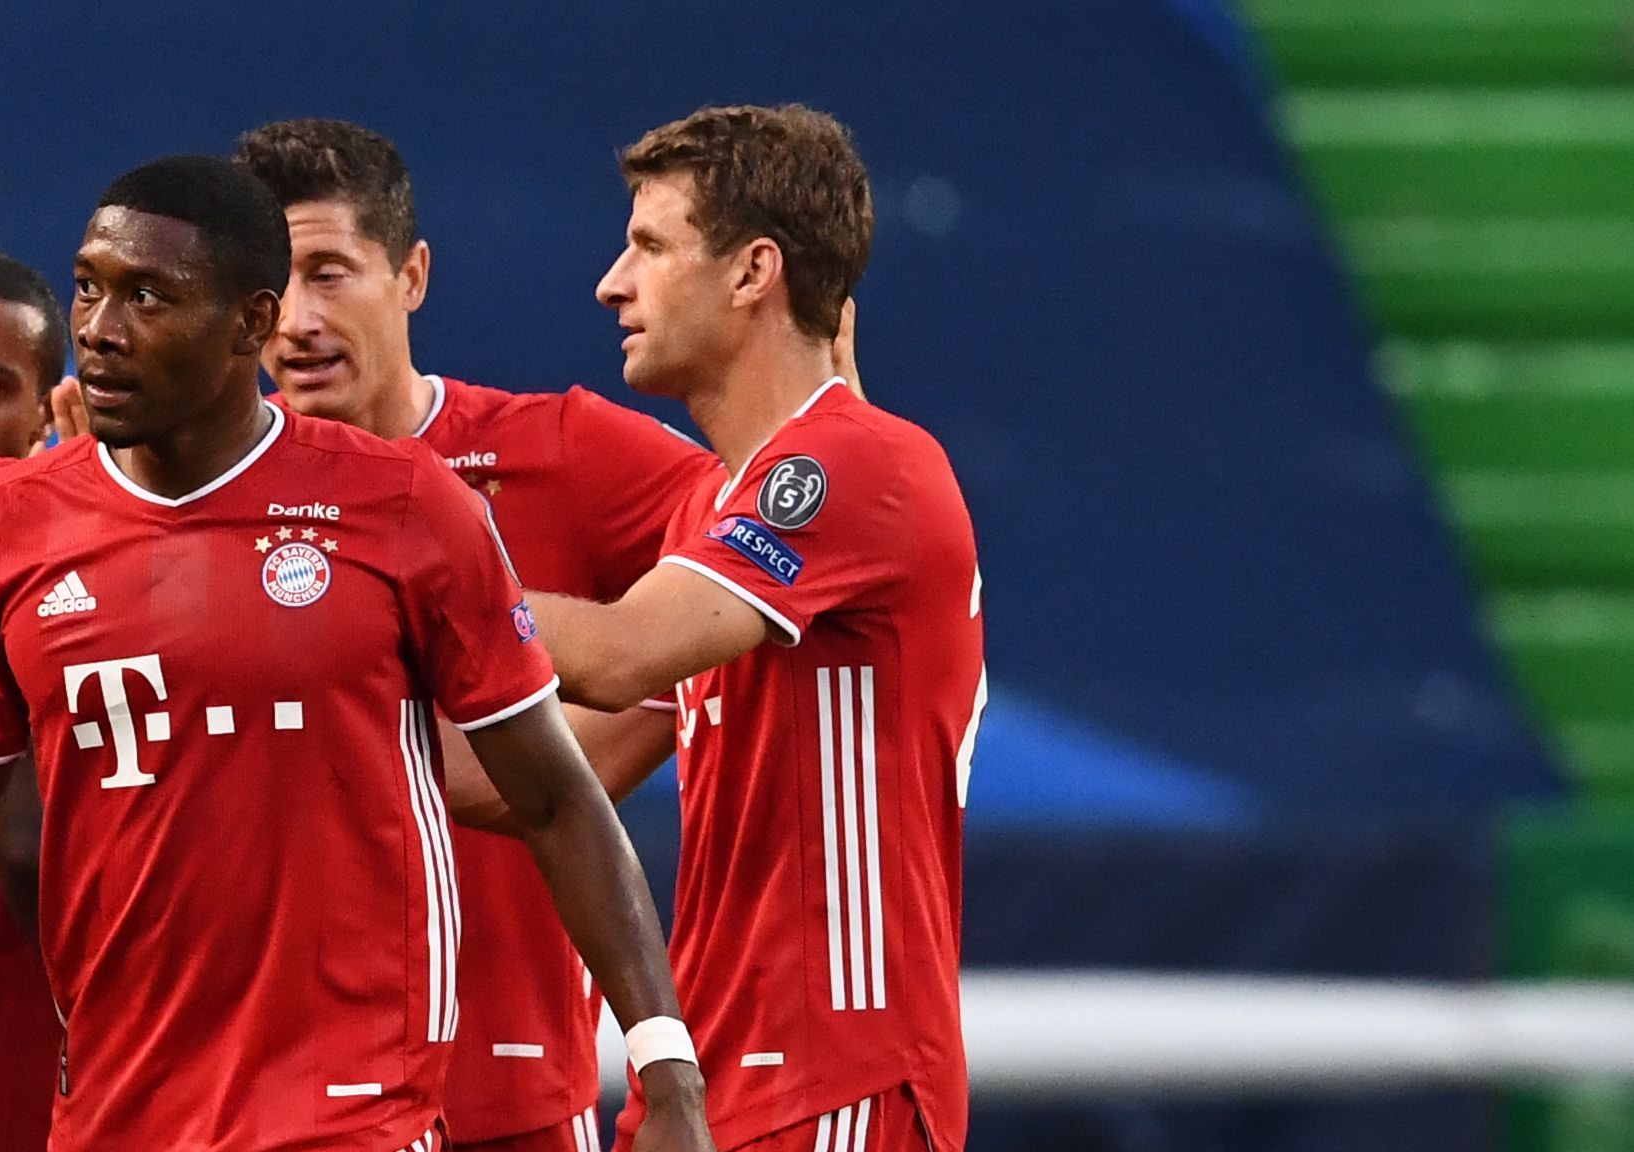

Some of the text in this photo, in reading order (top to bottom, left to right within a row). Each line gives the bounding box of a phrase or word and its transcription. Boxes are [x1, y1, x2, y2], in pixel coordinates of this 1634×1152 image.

[444, 450, 498, 469] anke
[777, 487, 799, 509] 5
[266, 502, 341, 521] Danke
[281, 547, 326, 572] BAYERN
[730, 524, 800, 578] RESPECT
[36, 595, 98, 618] adidas
